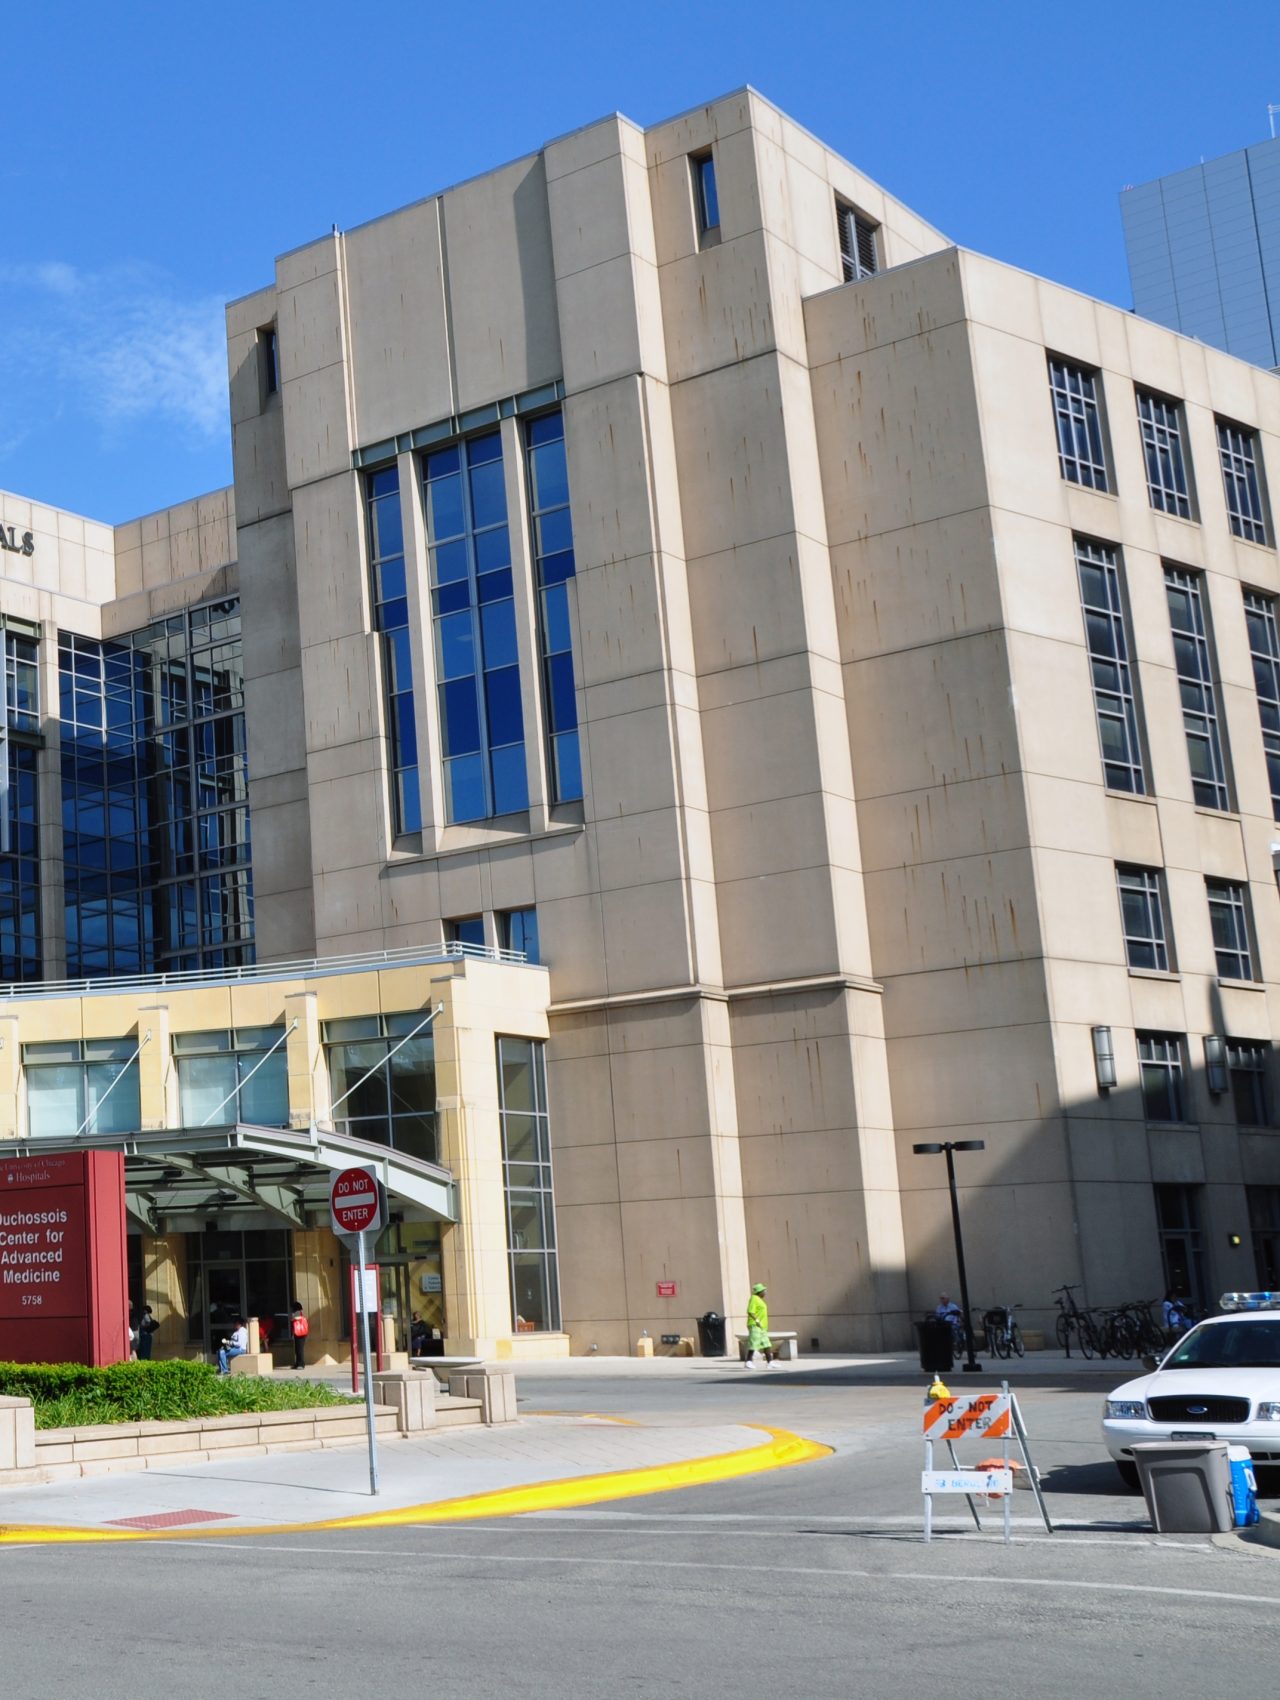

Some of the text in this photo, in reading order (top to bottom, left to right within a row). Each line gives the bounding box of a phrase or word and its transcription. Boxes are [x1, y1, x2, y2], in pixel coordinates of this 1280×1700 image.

[16, 1170, 51, 1183] Hospitals
[338, 1179, 368, 1193] DO NOT
[342, 1208, 368, 1221] ENTER
[46, 1229, 64, 1243] for
[1, 1248, 63, 1264] Advanced
[3, 1268, 60, 1284] Medicine
[22, 1295, 42, 1305] 5758
[939, 1403, 953, 1414] DO
[968, 1401, 993, 1413] NOT
[948, 1416, 992, 1430] ENTER
